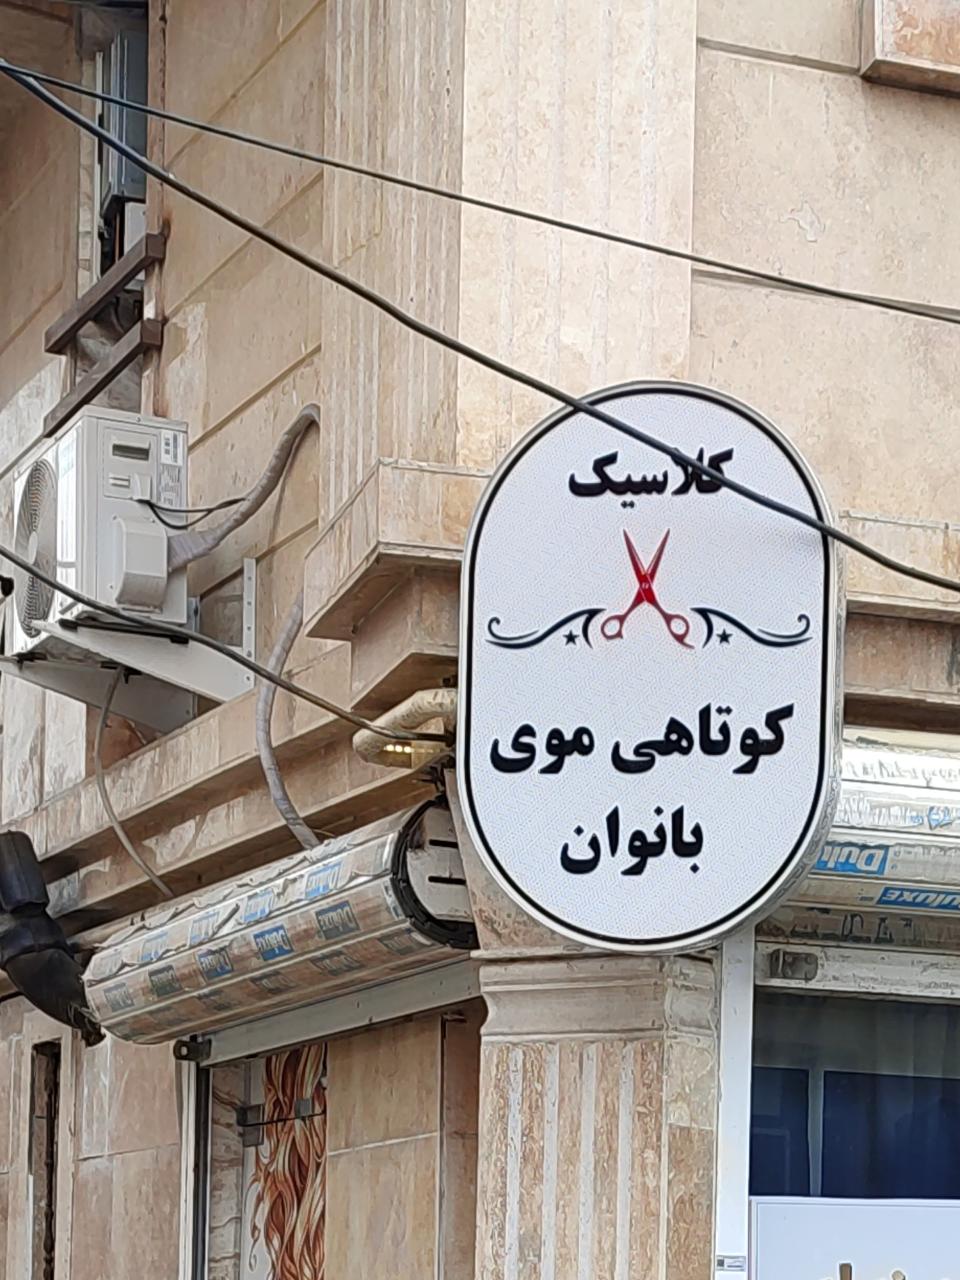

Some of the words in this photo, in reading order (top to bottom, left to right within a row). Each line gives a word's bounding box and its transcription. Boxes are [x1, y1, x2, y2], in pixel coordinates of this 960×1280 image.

[568, 447, 734, 510] کلاسیک
[489, 723, 596, 775] موی
[610, 702, 795, 775] کوتاهی
[560, 805, 704, 877] بانوان
